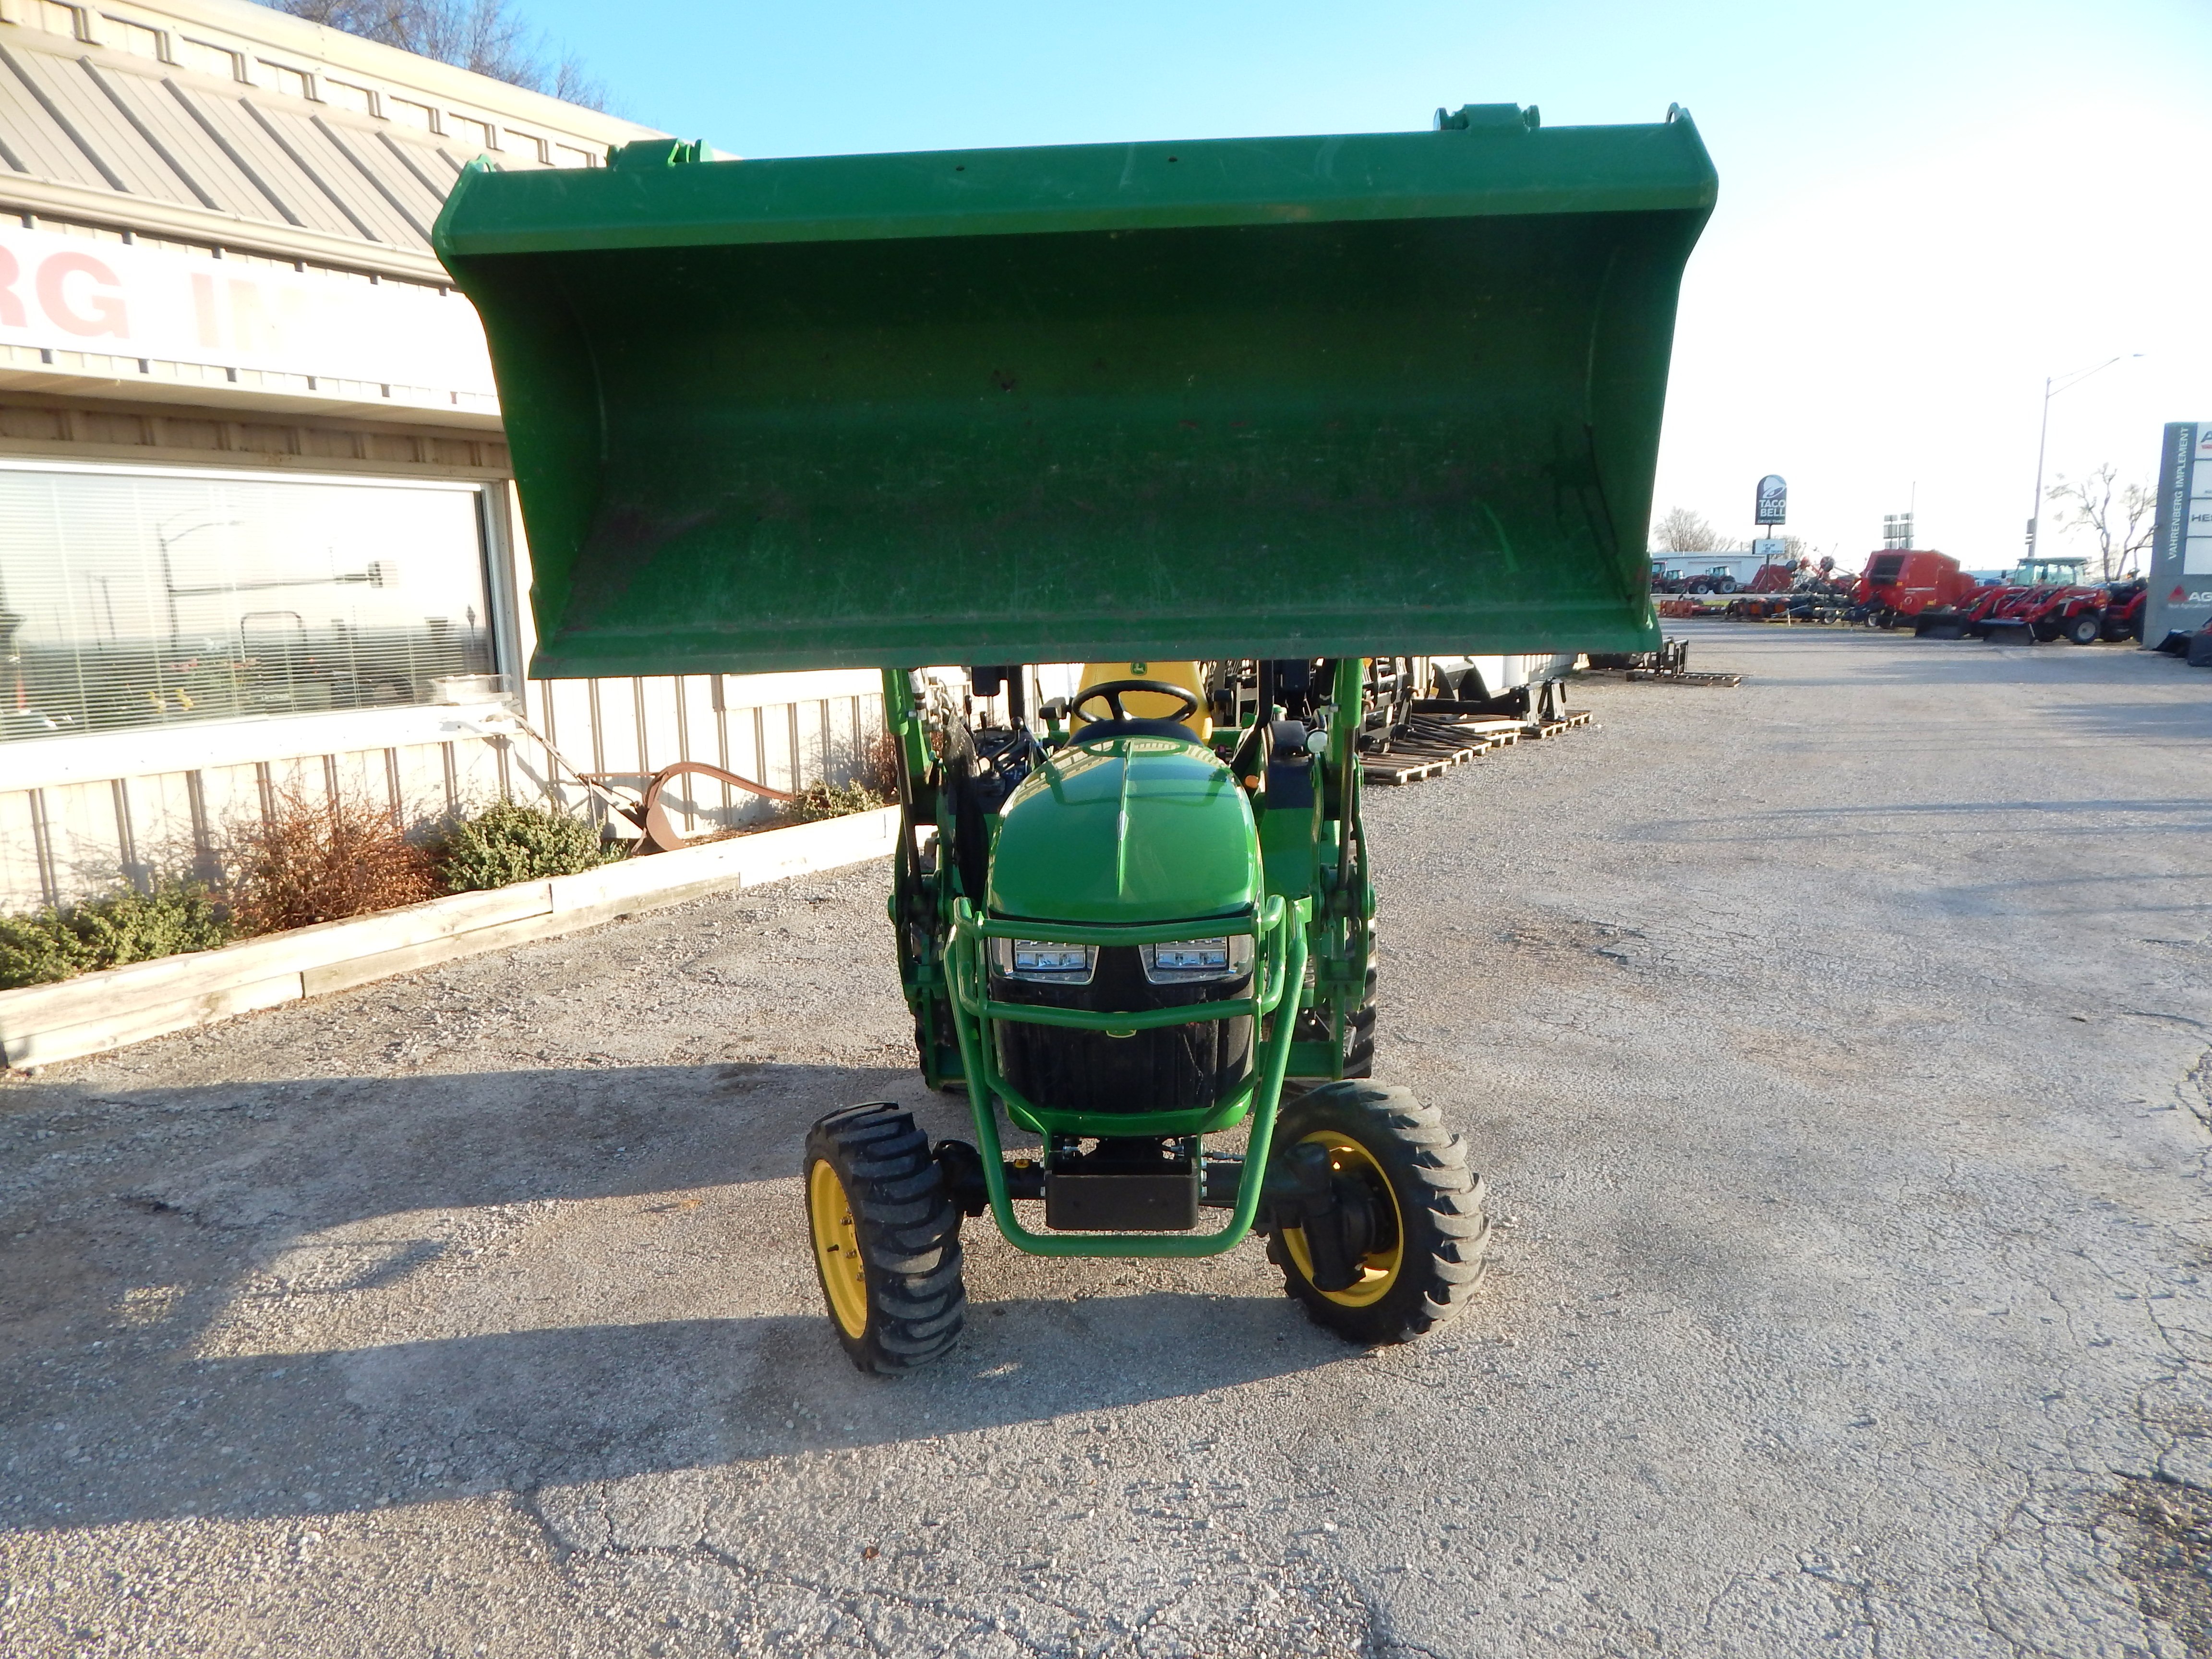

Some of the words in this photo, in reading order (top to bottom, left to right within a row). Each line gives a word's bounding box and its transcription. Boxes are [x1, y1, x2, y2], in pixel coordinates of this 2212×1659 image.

[2168, 491, 2183, 560] VAHRENBERG
[2176, 427, 2188, 488] IMPLEMENT
[1759, 499, 1786, 508] TACO
[1760, 508, 1785, 517] BELL
[2191, 514, 2212, 522] HE
[2189, 591, 2212, 601] AG
